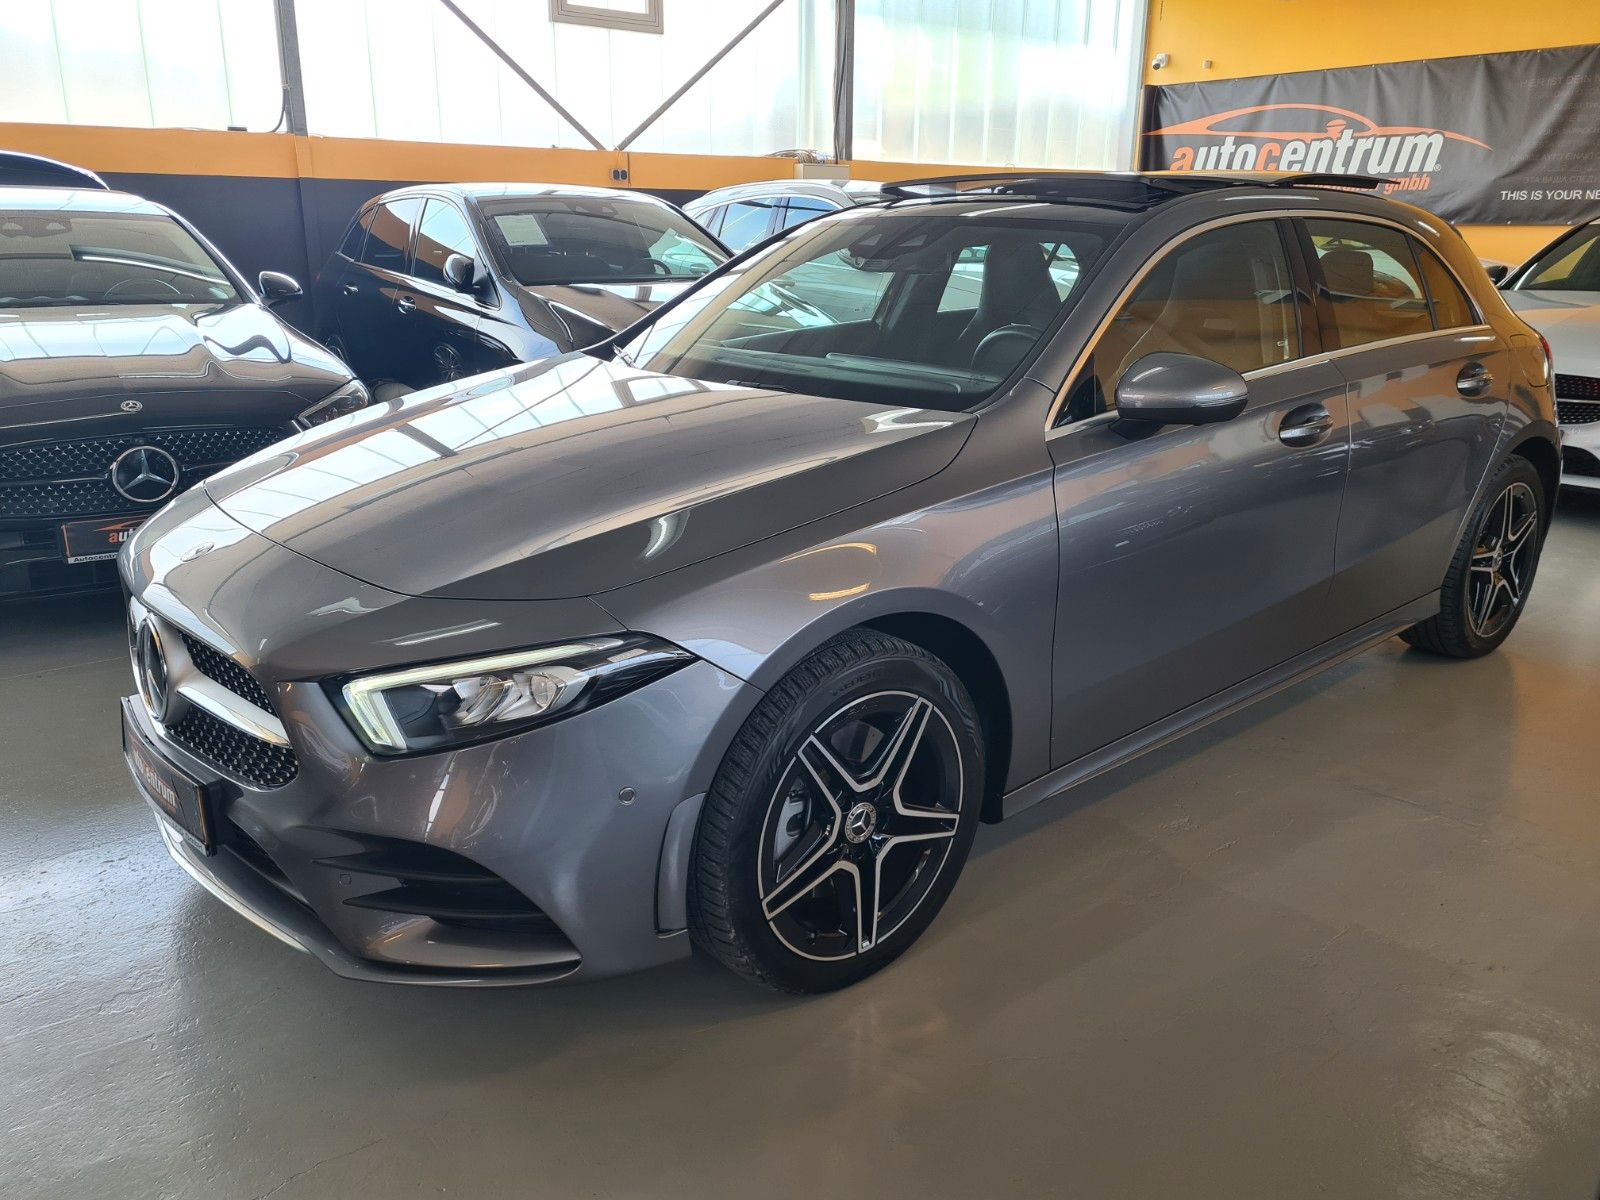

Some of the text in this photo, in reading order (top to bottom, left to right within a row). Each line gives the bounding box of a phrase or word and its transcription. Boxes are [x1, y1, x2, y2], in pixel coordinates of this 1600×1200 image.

[1169, 129, 1444, 175] autocentrum
[1500, 190, 1528, 200] THIS
[1530, 190, 1543, 200] IS
[1546, 189, 1582, 200] YOUR
